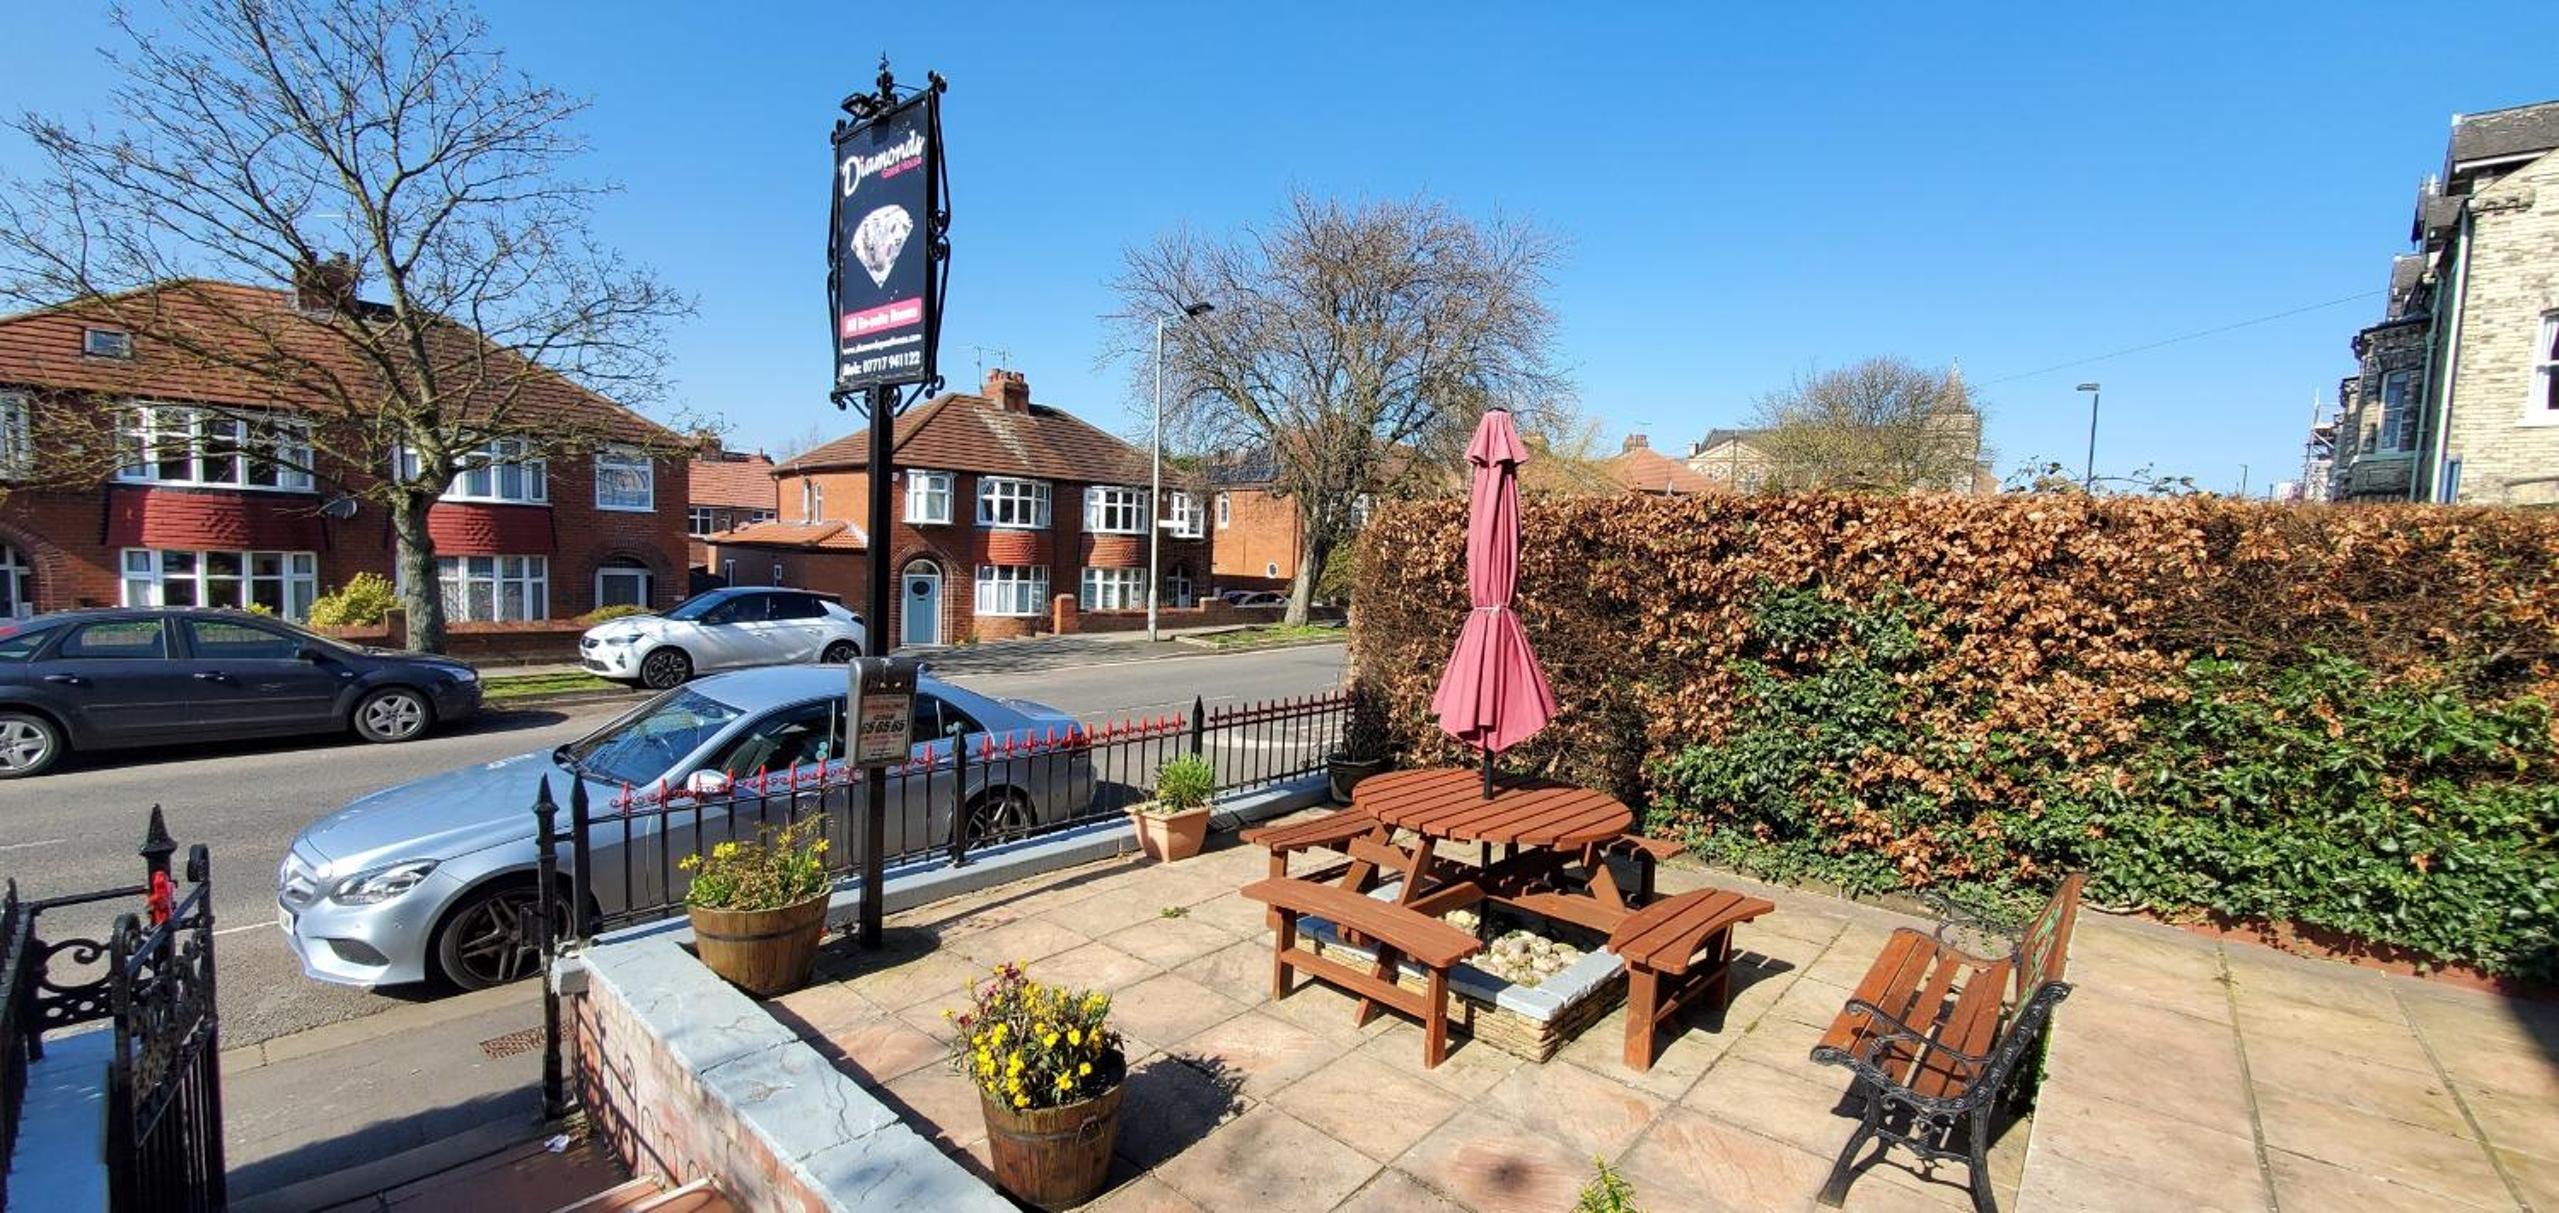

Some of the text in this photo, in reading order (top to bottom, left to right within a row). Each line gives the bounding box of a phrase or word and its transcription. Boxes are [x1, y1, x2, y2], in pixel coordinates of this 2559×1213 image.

[842, 129, 925, 197] Diamonds
[863, 356, 888, 373] 07717
[889, 351, 920, 369] 941122
